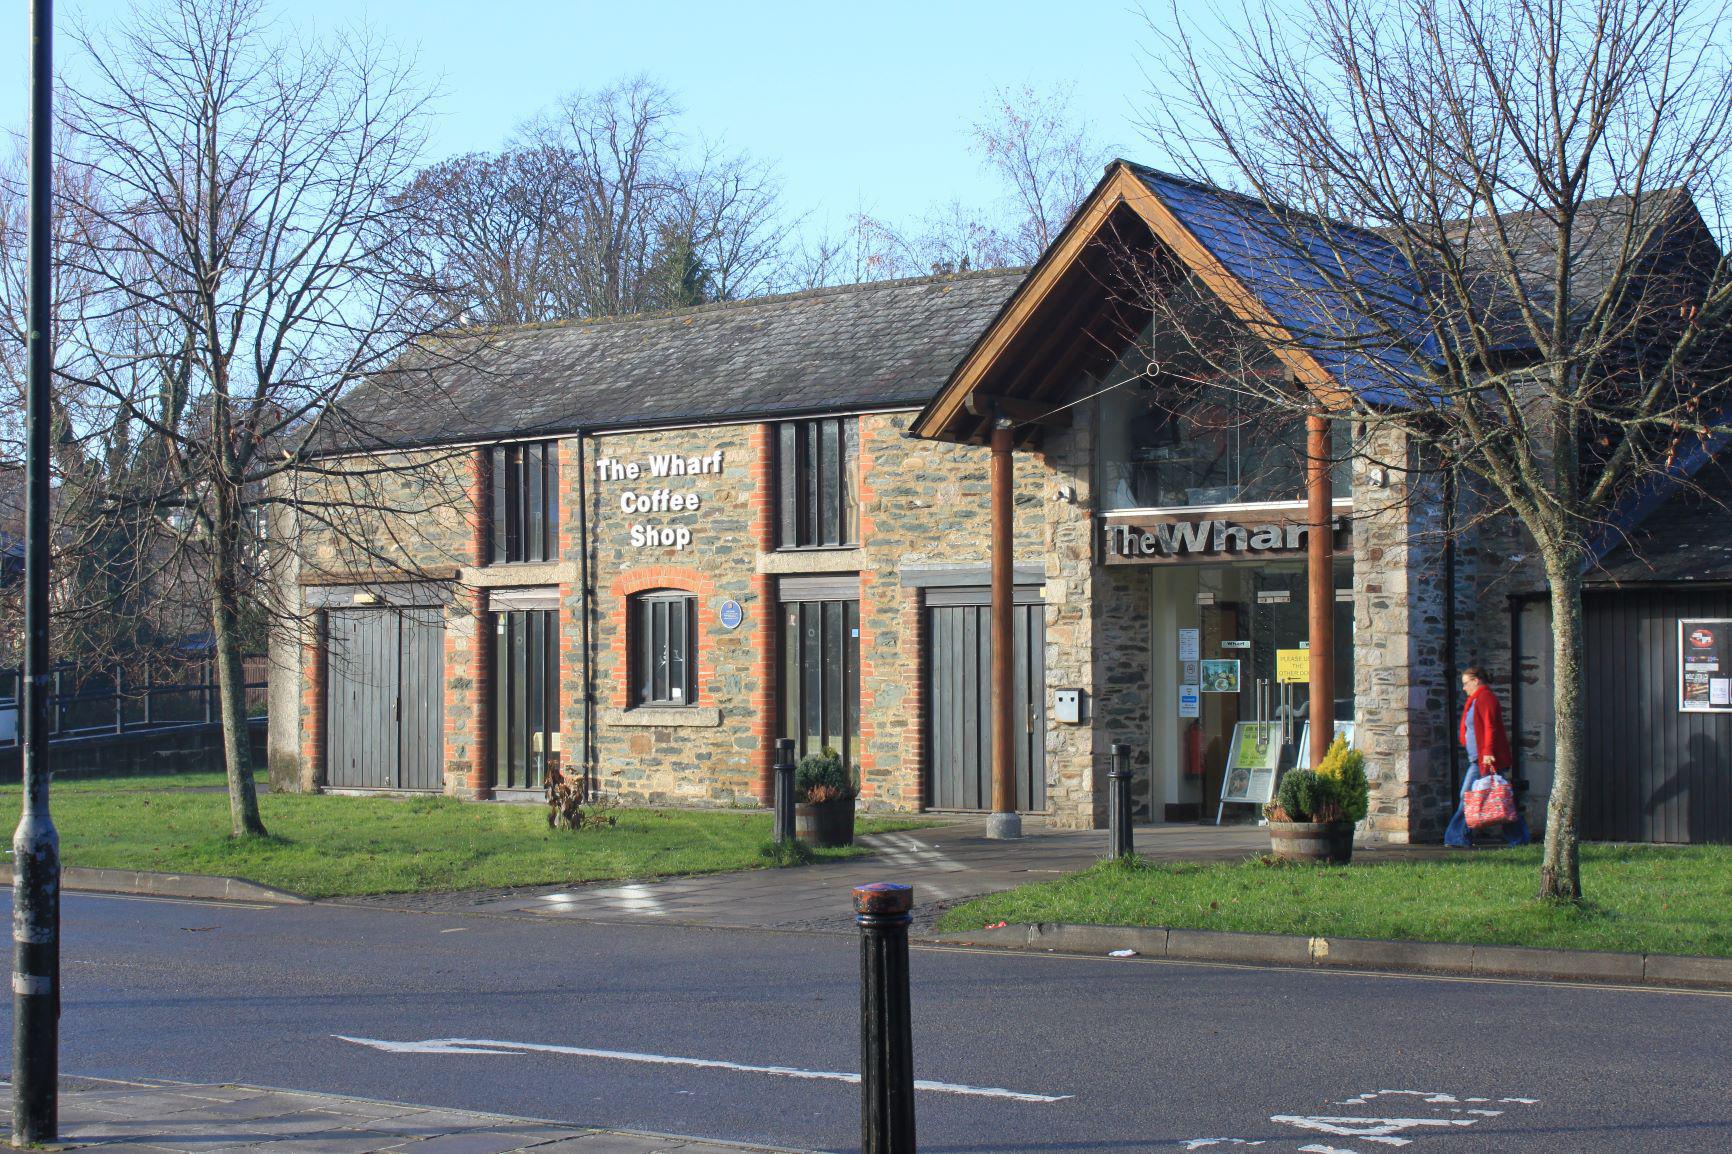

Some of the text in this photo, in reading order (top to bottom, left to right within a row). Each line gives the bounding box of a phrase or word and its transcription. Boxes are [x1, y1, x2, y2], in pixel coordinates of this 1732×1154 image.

[597, 450, 723, 481] The Wharf
[621, 489, 700, 514] Coffee
[630, 524, 692, 550] Shop
[1104, 524, 1155, 555] The
